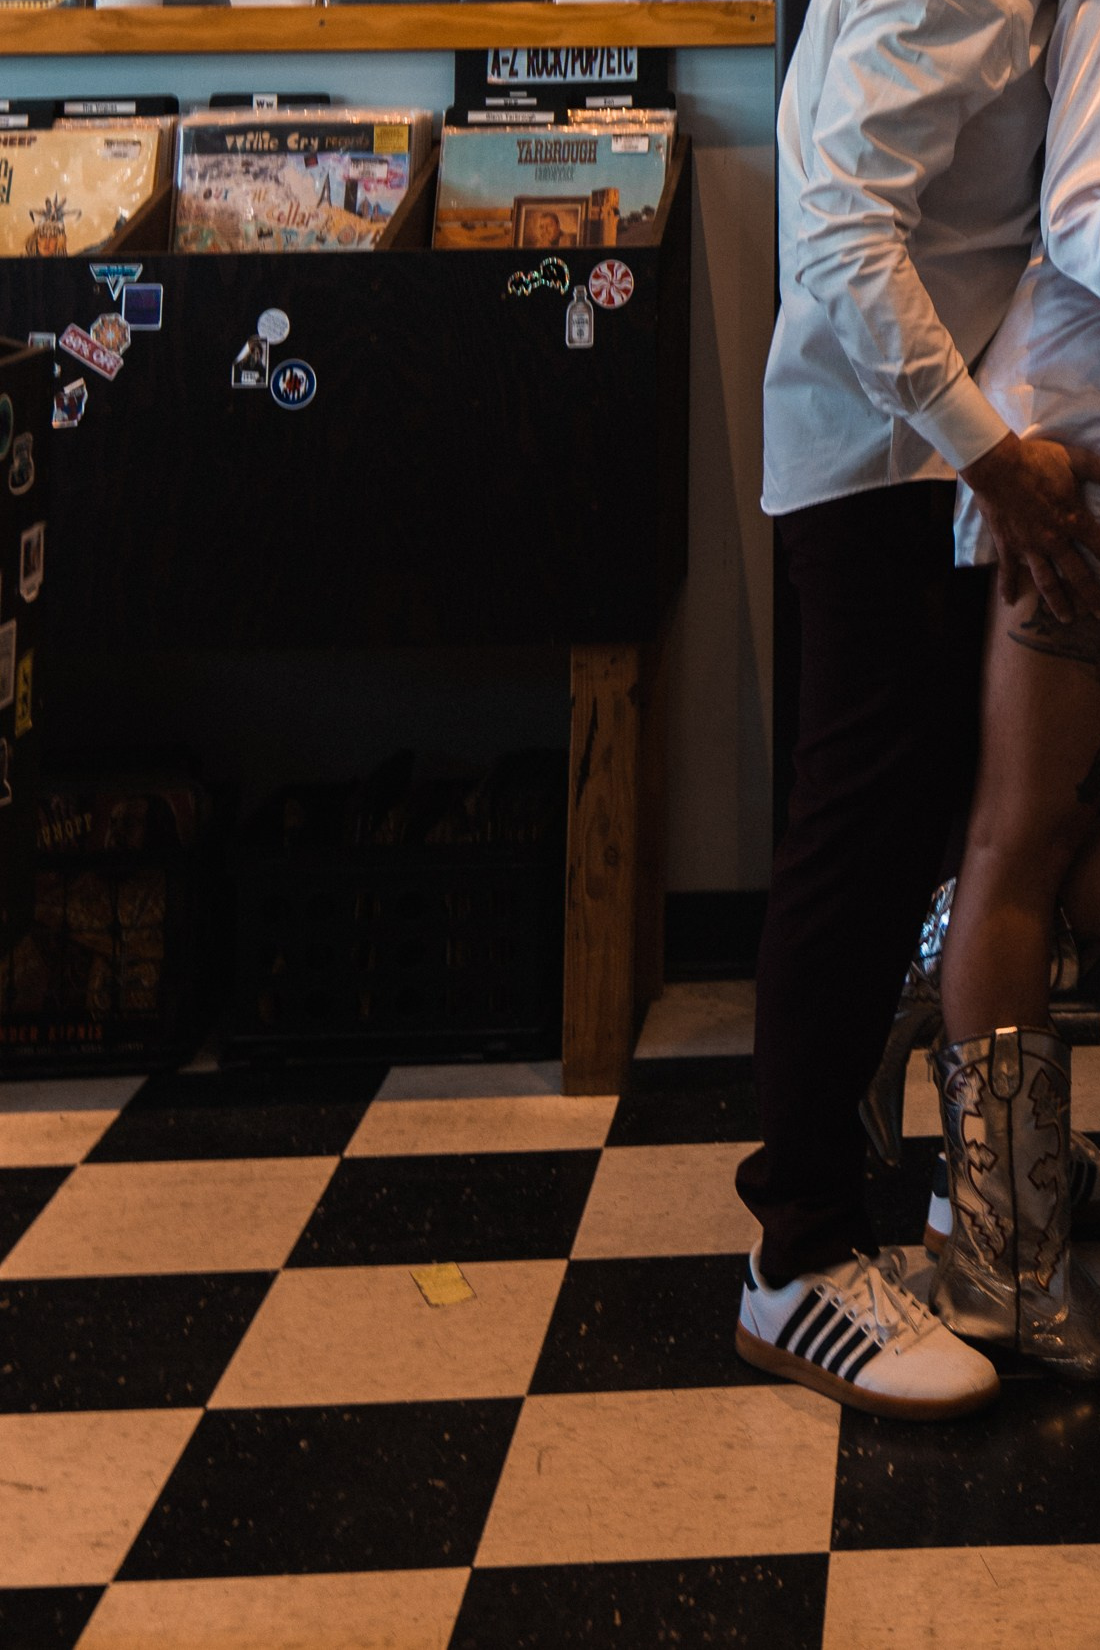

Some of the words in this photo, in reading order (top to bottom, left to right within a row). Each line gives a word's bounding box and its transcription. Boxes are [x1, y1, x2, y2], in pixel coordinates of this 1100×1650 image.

[490, 48, 519, 77] A-Z
[526, 48, 634, 80] ROCK/POP/ETC
[287, 131, 319, 152] Cry
[517, 138, 599, 166] YARBROUGH
